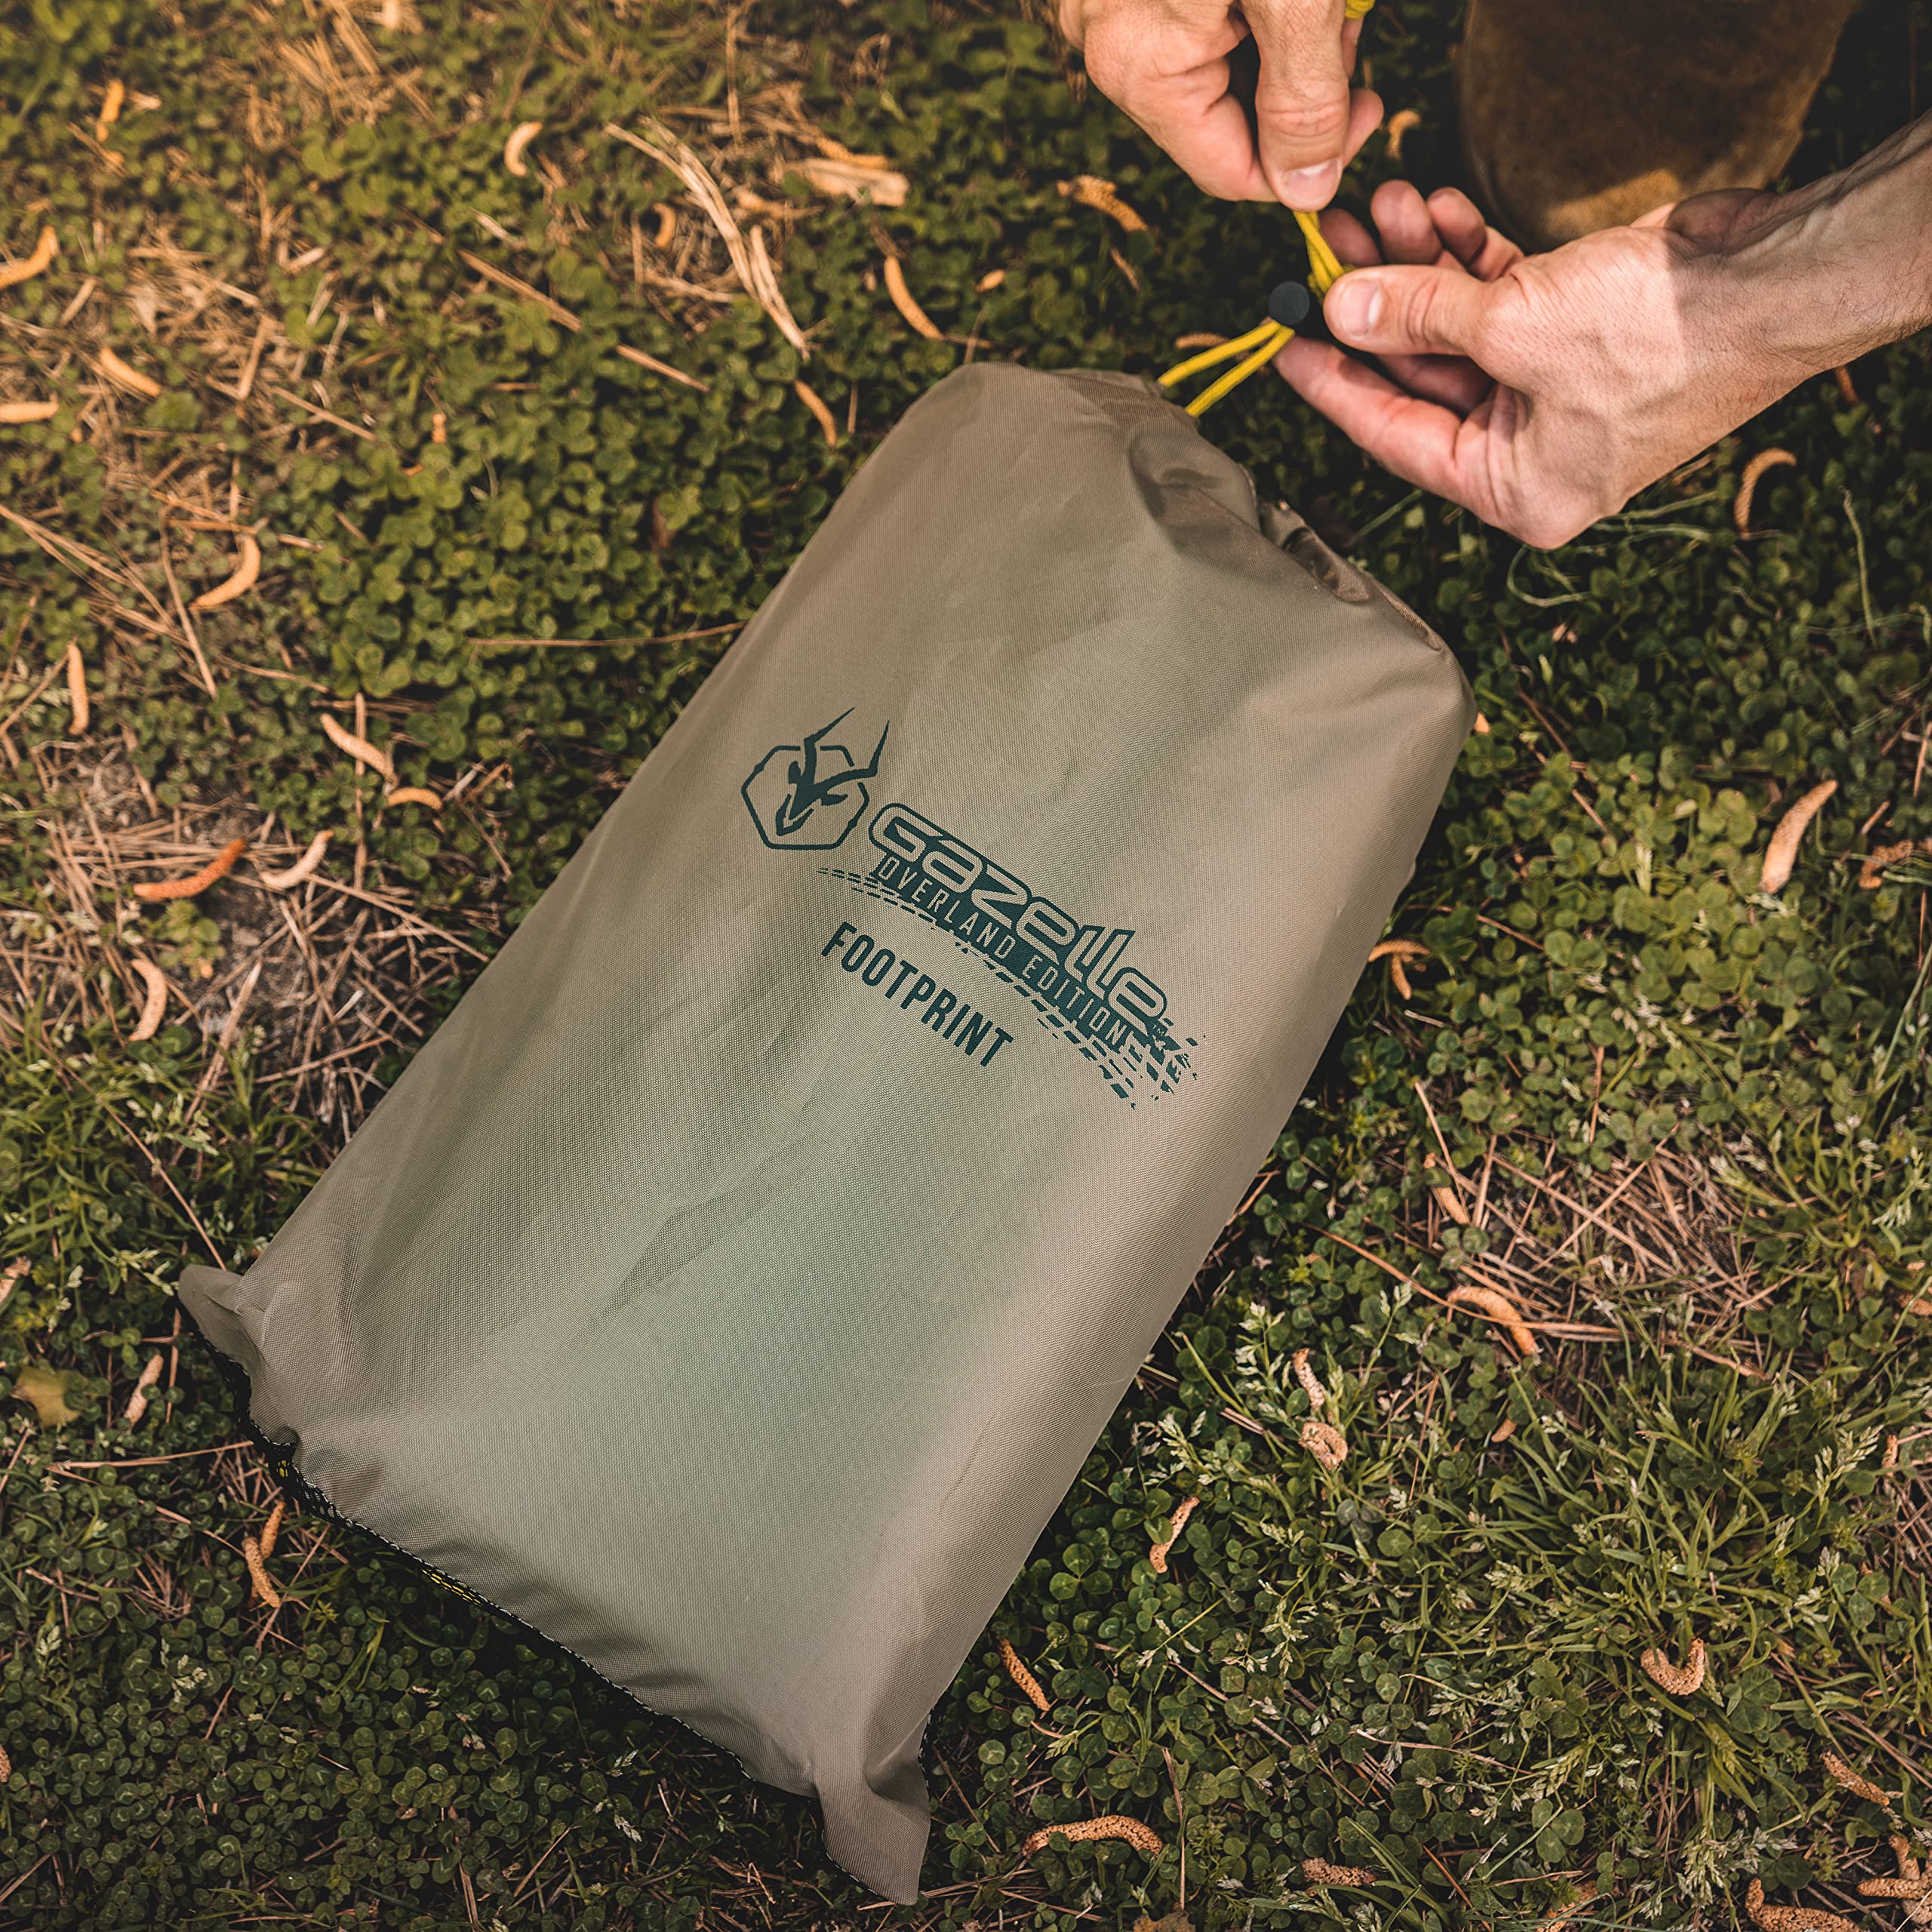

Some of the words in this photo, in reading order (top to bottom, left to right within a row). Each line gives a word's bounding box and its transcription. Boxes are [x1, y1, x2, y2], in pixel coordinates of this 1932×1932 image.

[820, 921, 1015, 1067] FOOTPRINT
[878, 855, 1016, 960] OVERLAND
[1021, 954, 1127, 1046] EDITION
